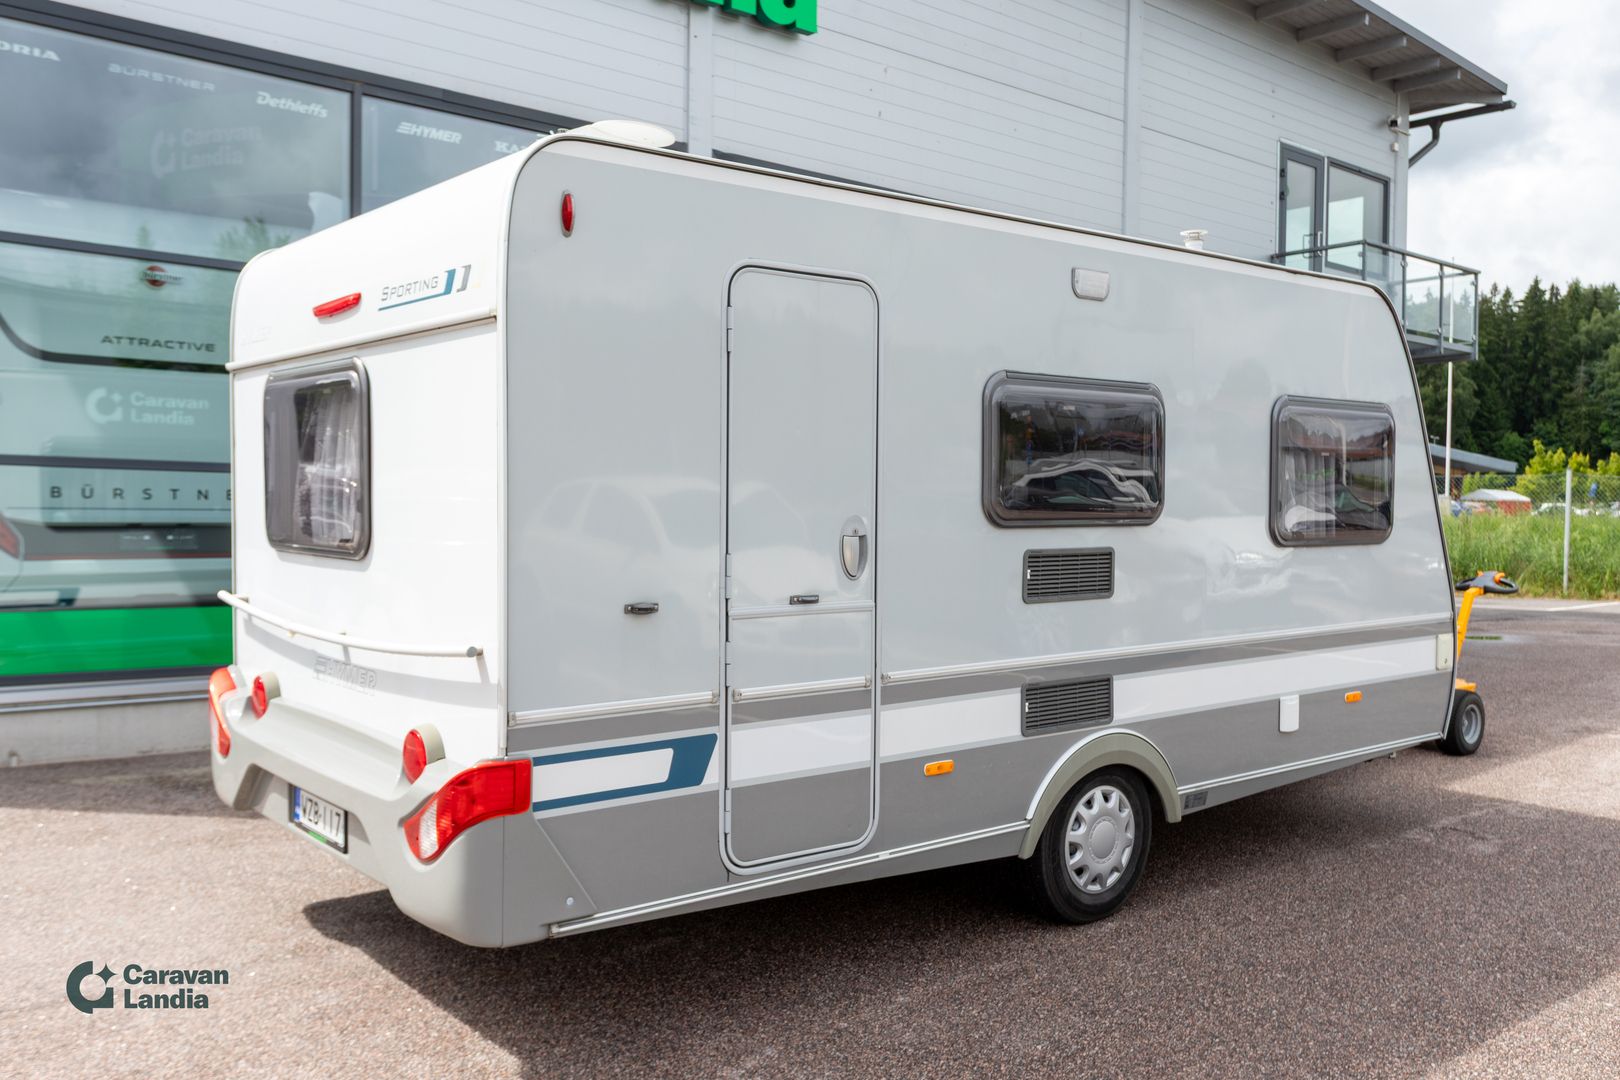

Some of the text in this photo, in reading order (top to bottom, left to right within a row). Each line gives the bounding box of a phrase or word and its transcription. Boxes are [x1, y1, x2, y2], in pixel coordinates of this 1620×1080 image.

[256, 91, 328, 118] Dethleffs
[397, 121, 463, 145] HYMER
[381, 276, 439, 302] SPORTING
[101, 334, 217, 353] ATTRACTIVE
[129, 391, 210, 411] Caravan
[130, 410, 195, 426] Landia
